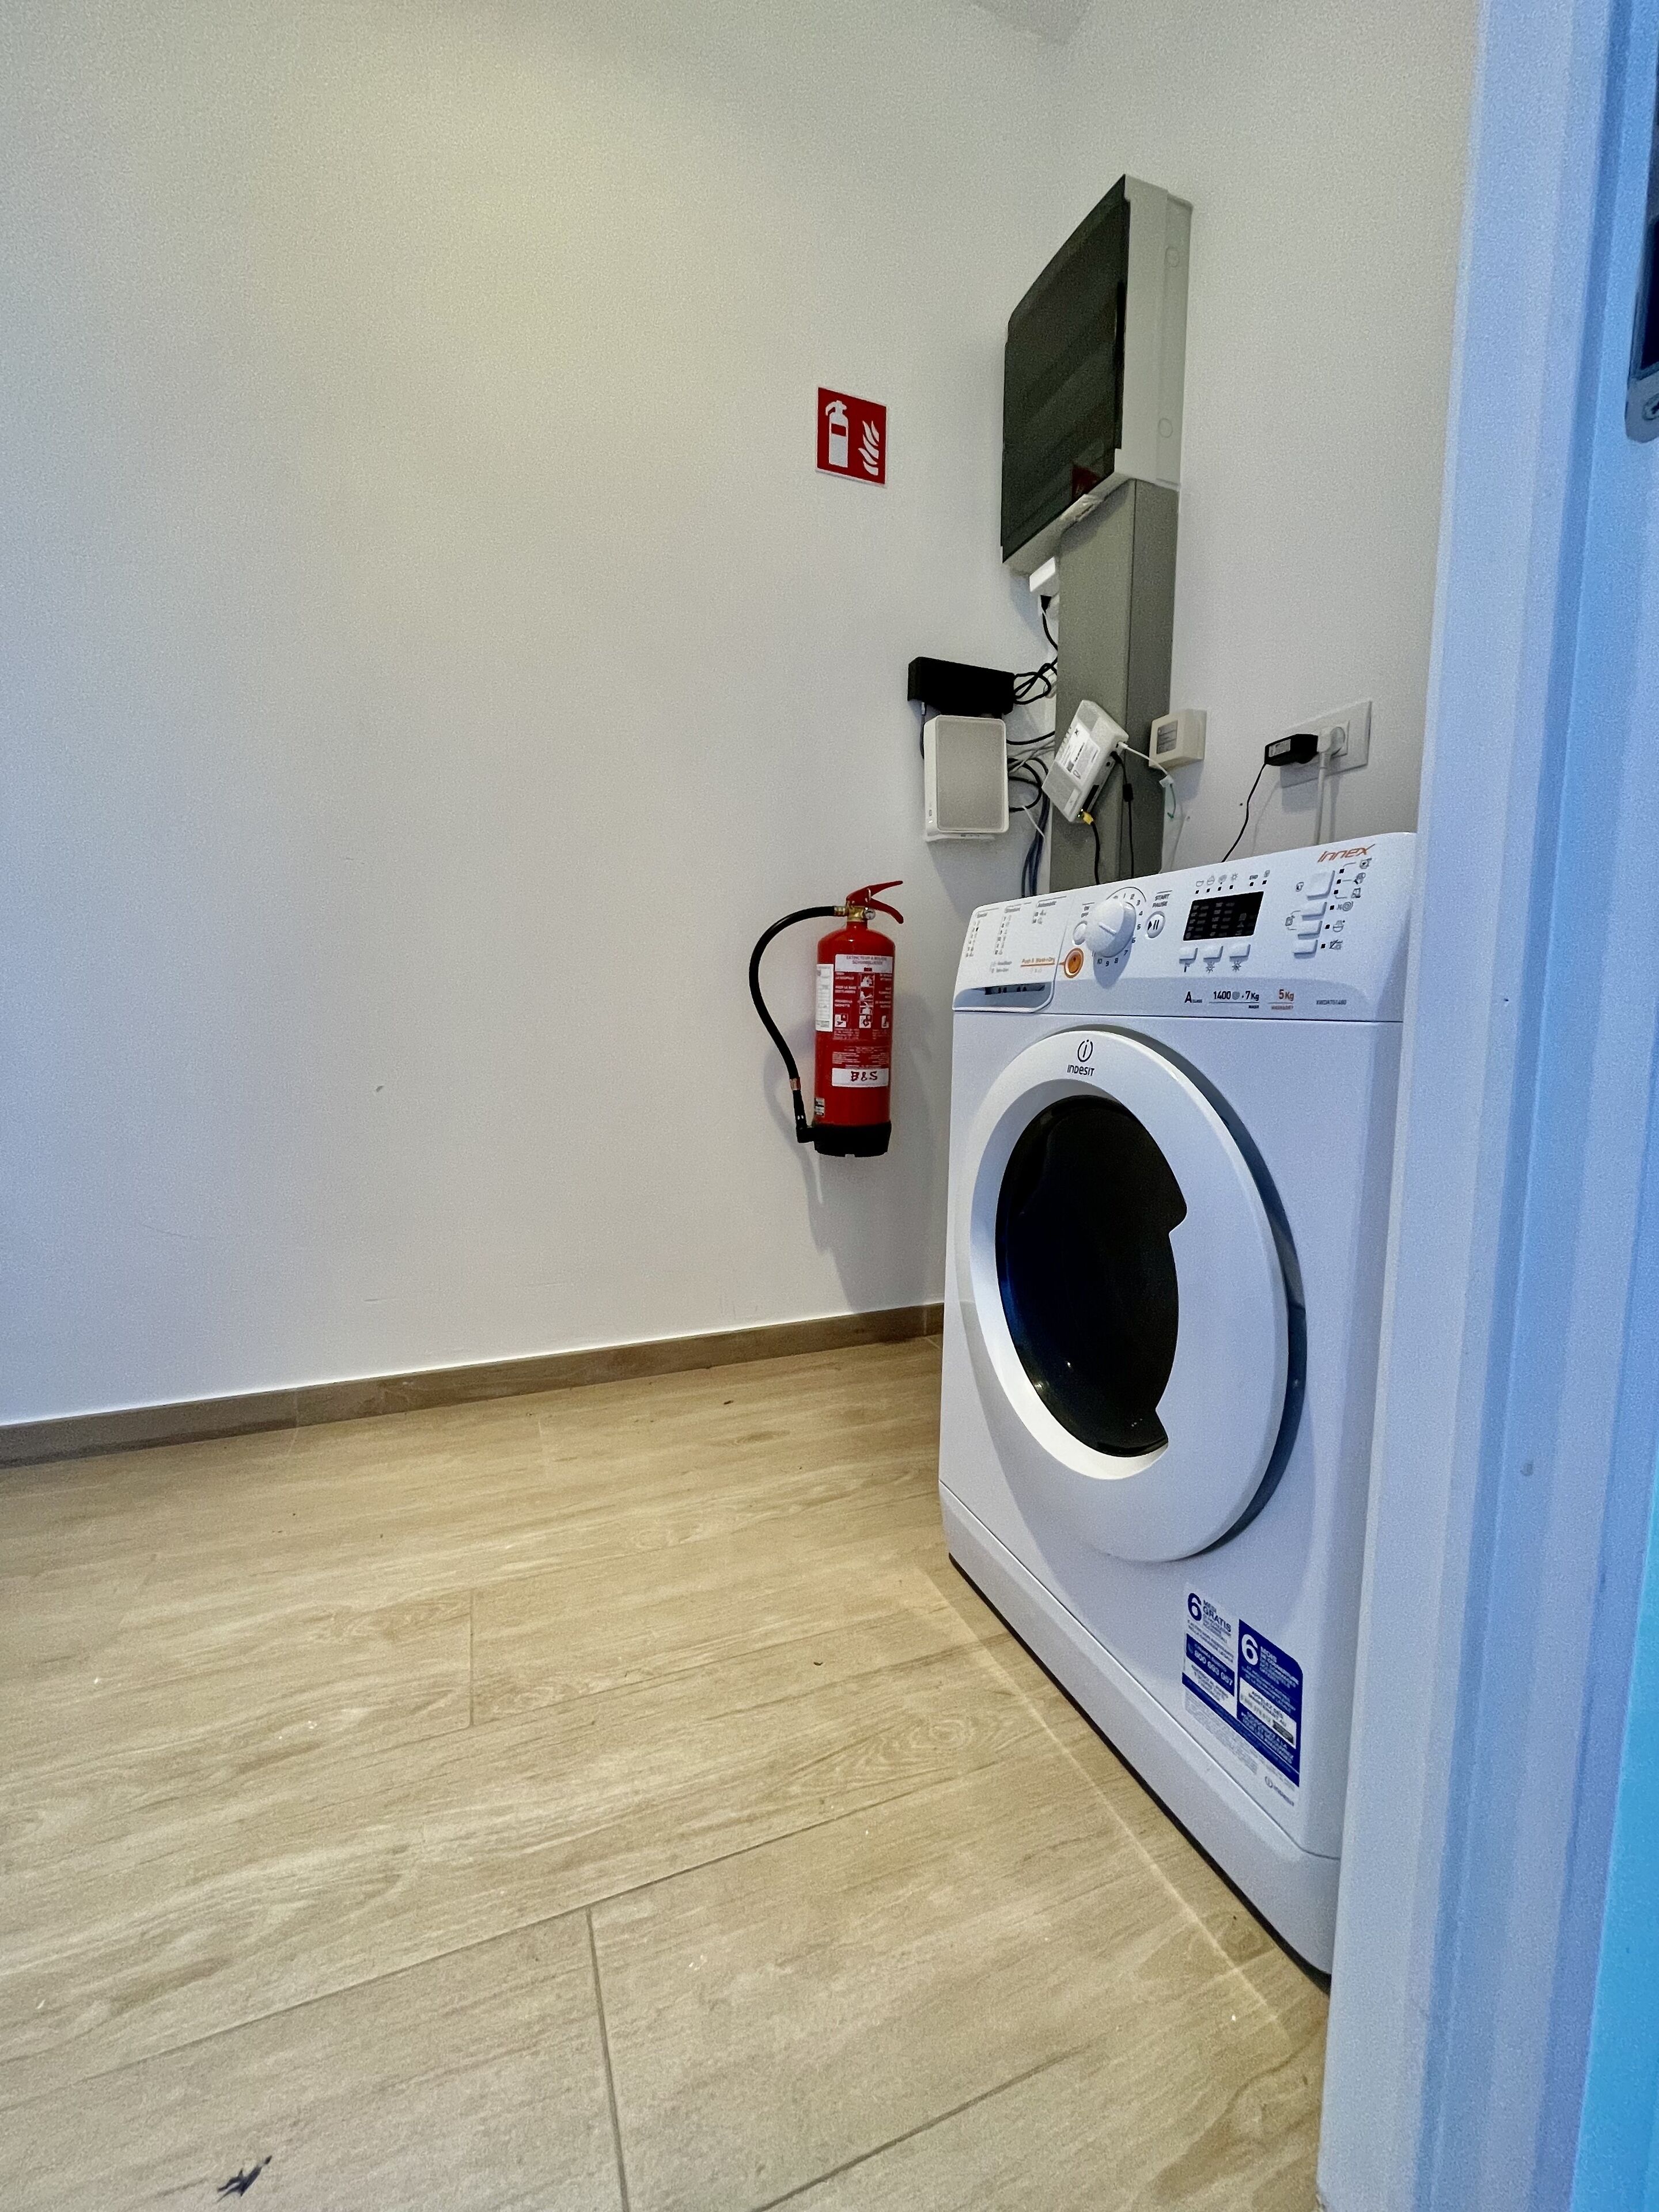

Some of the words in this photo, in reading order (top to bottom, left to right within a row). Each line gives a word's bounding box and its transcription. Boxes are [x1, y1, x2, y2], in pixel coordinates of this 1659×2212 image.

[1184, 991, 1192, 1003] A
[1213, 991, 1232, 1000] 1400
[1188, 1593, 1202, 1621] 6
[1203, 1606, 1232, 1633] GRATIS
[1241, 1634, 1258, 1665] 6
